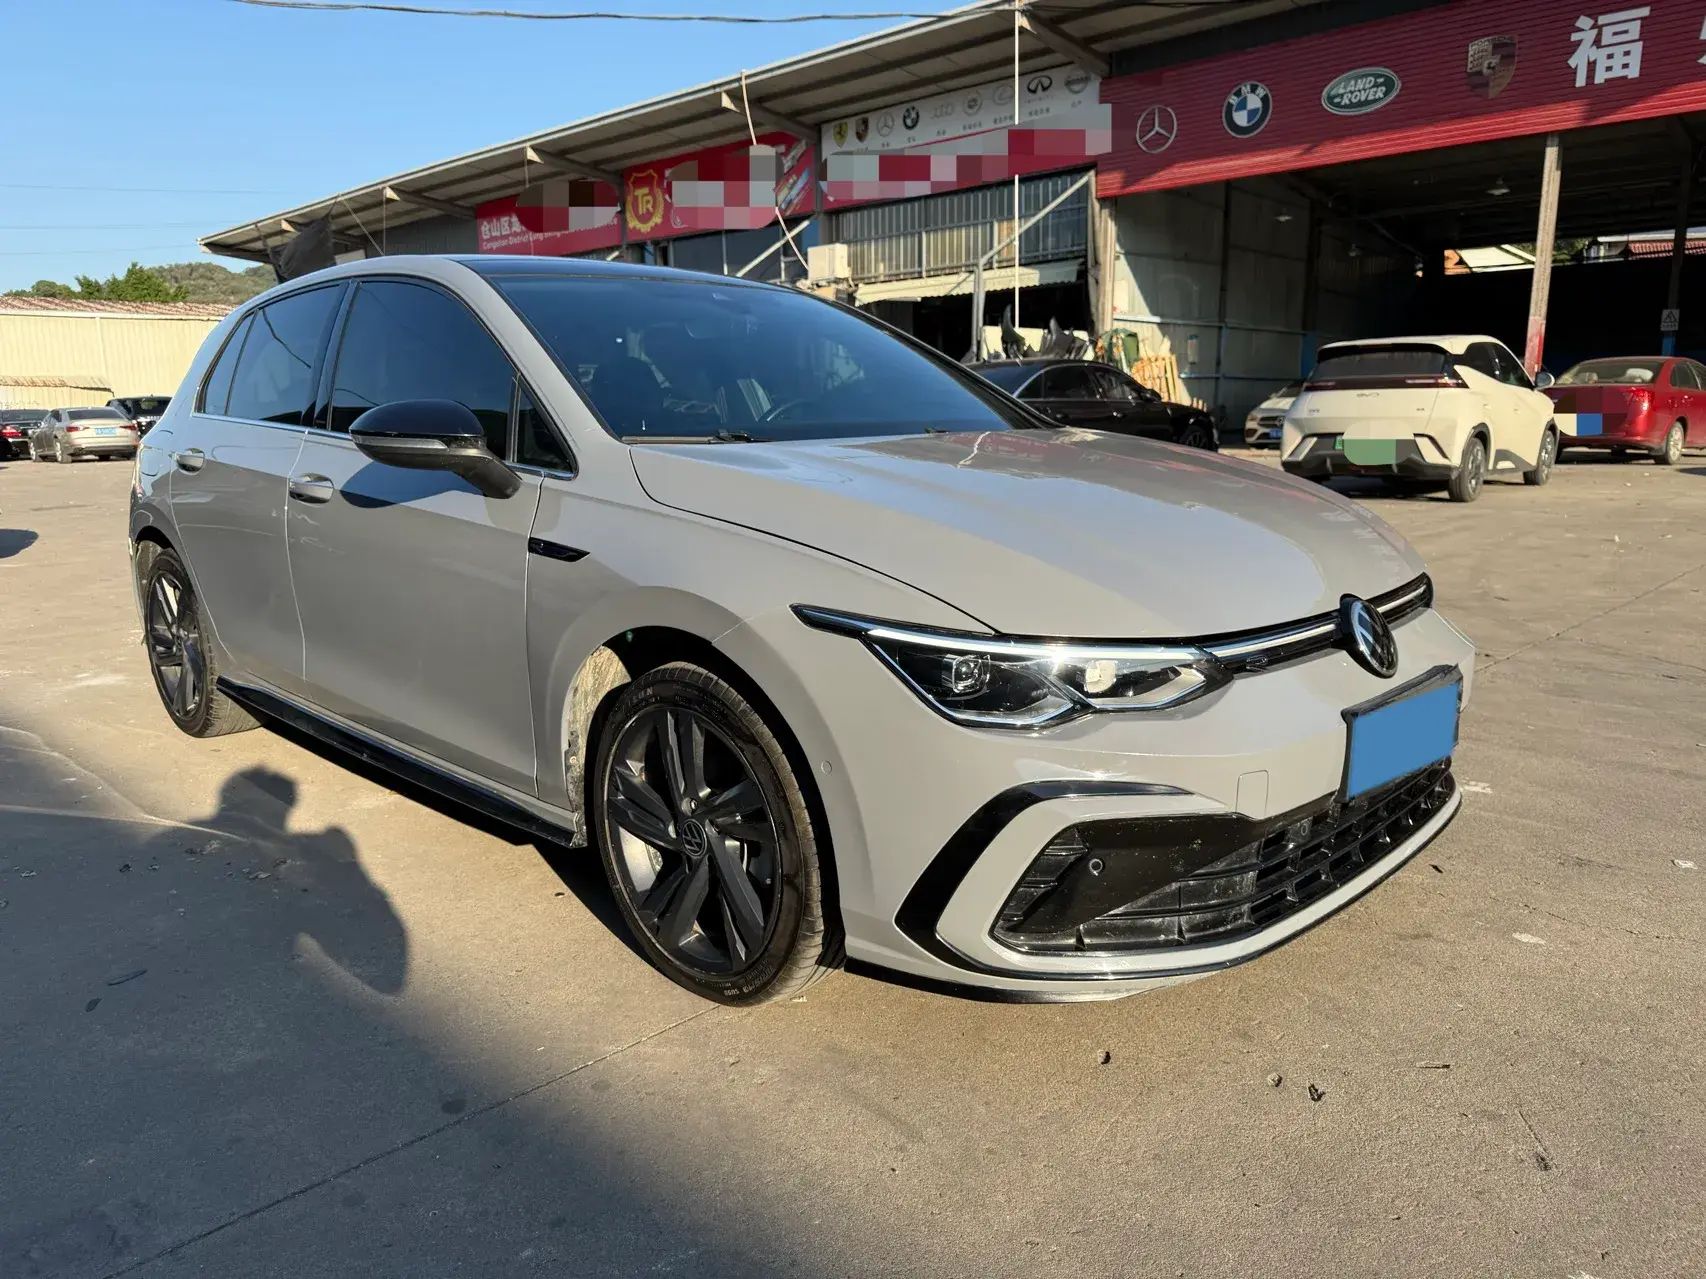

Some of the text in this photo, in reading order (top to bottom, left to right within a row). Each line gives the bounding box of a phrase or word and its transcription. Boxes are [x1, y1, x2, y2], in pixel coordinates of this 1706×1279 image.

[1567, 6, 1706, 87] 福
[1227, 84, 1267, 105] BMW
[1338, 76, 1375, 94] LAND
[1341, 86, 1387, 106] ROVER
